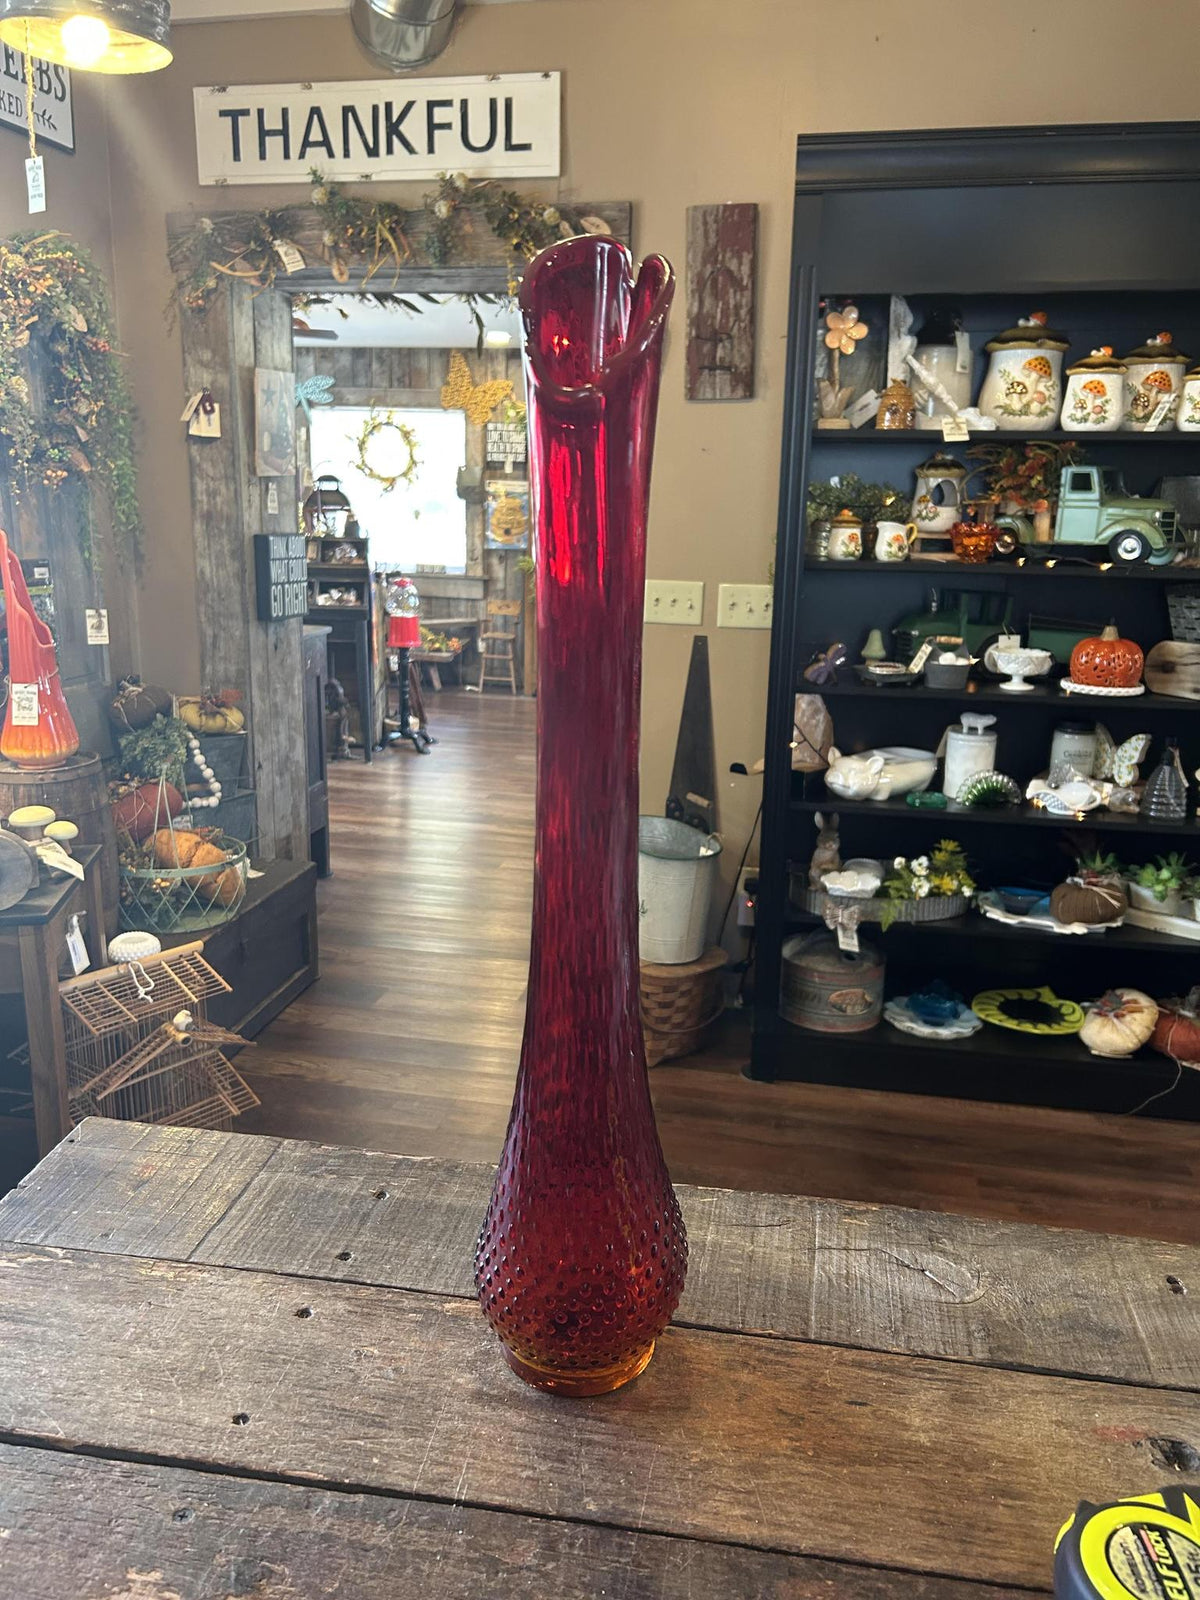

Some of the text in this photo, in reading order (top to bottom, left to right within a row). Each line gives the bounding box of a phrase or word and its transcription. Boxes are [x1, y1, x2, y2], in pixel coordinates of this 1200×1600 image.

[218, 96, 533, 163] THANKFUL
[271, 582, 309, 618] GO RIGHT
